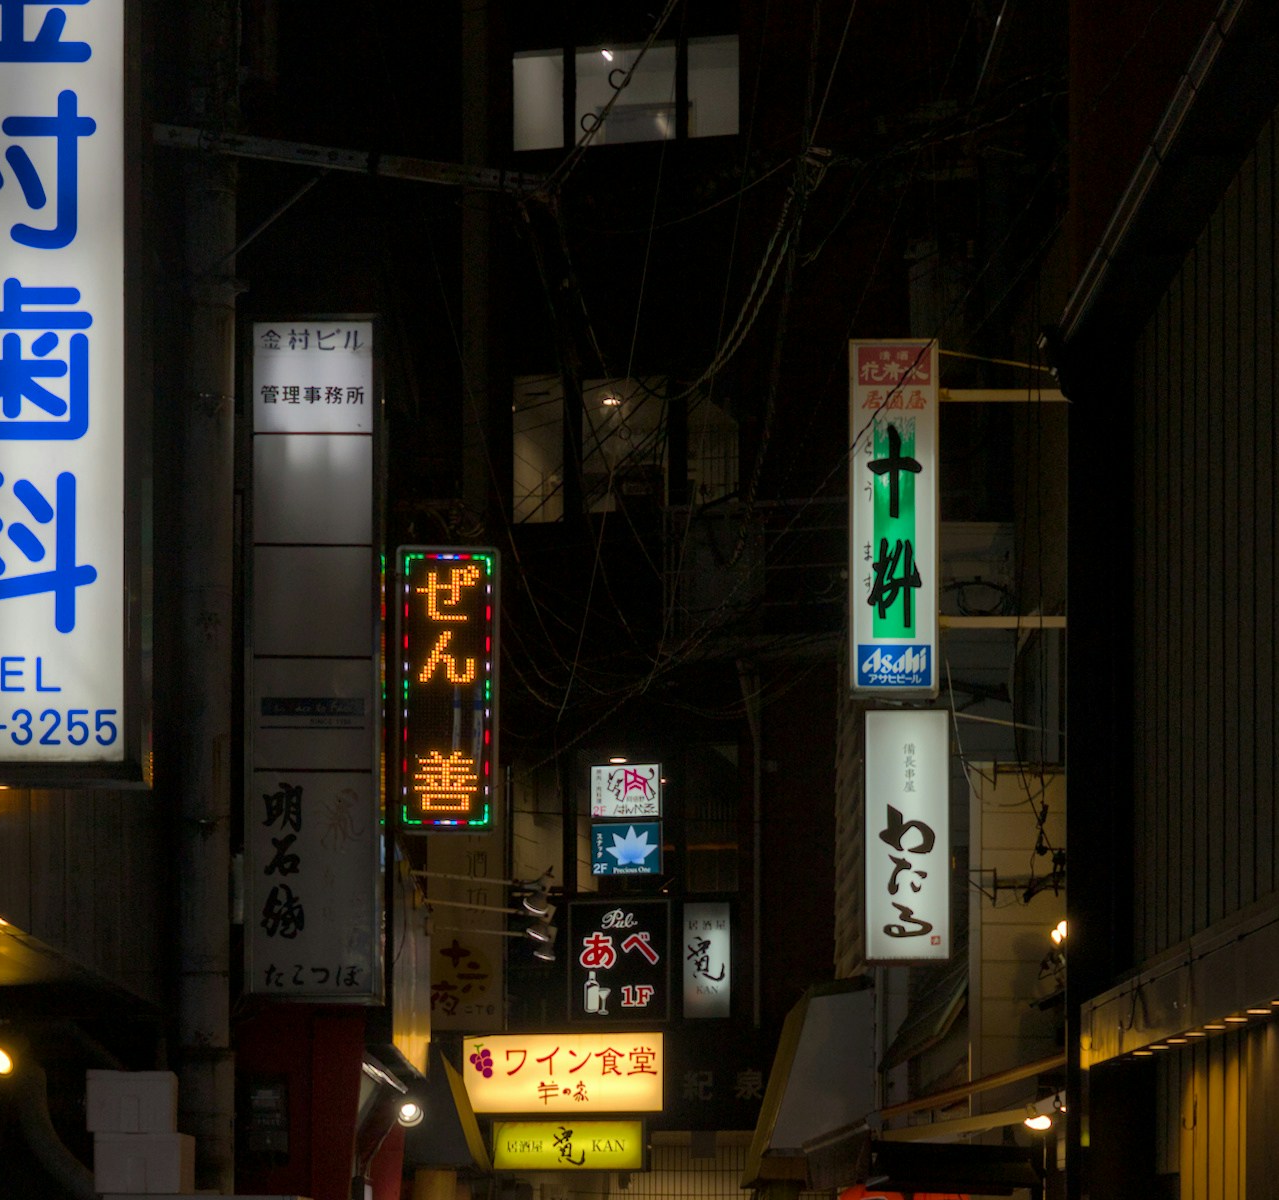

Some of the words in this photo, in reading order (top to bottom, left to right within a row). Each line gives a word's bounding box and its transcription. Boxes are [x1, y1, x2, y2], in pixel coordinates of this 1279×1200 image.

[260, 328, 365, 352] 金村ビル
[260, 385, 365, 406] 管理事務所
[415, 564, 480, 684] ぜん
[861, 646, 927, 674] Asahi
[868, 673, 923, 684] アサヒビール
[413, 749, 478, 812] 善
[592, 862, 609, 875] 2F
[879, 803, 936, 939] わたる
[580, 931, 660, 970] あべ
[264, 963, 364, 988] たこつぼ
[621, 984, 654, 1008] 1F
[505, 1045, 658, 1077] ワイン食堂
[591, 1138, 626, 1153] KAN
